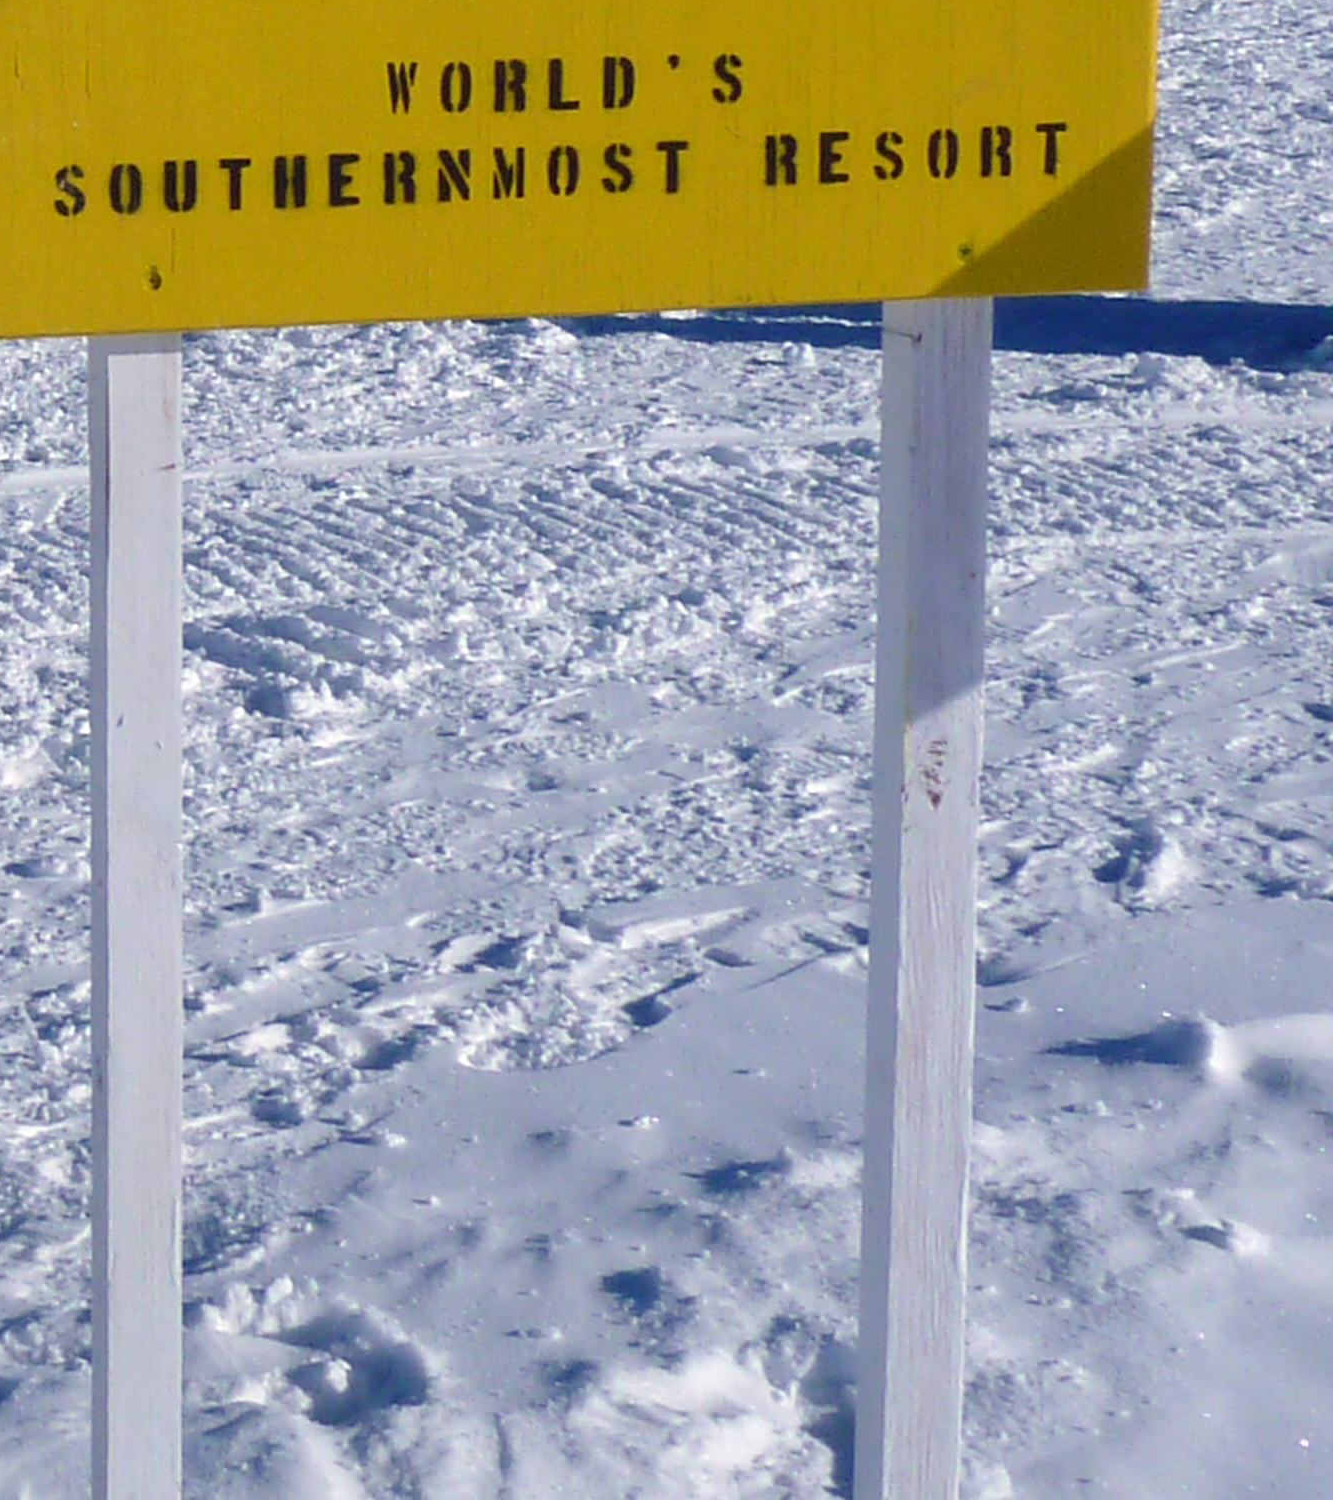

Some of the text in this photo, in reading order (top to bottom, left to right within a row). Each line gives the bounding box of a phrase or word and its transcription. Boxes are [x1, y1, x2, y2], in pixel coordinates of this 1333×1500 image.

[387, 53, 744, 114] WORLD'S
[53, 121, 1067, 217] SOUTHERNMOST RESORT
